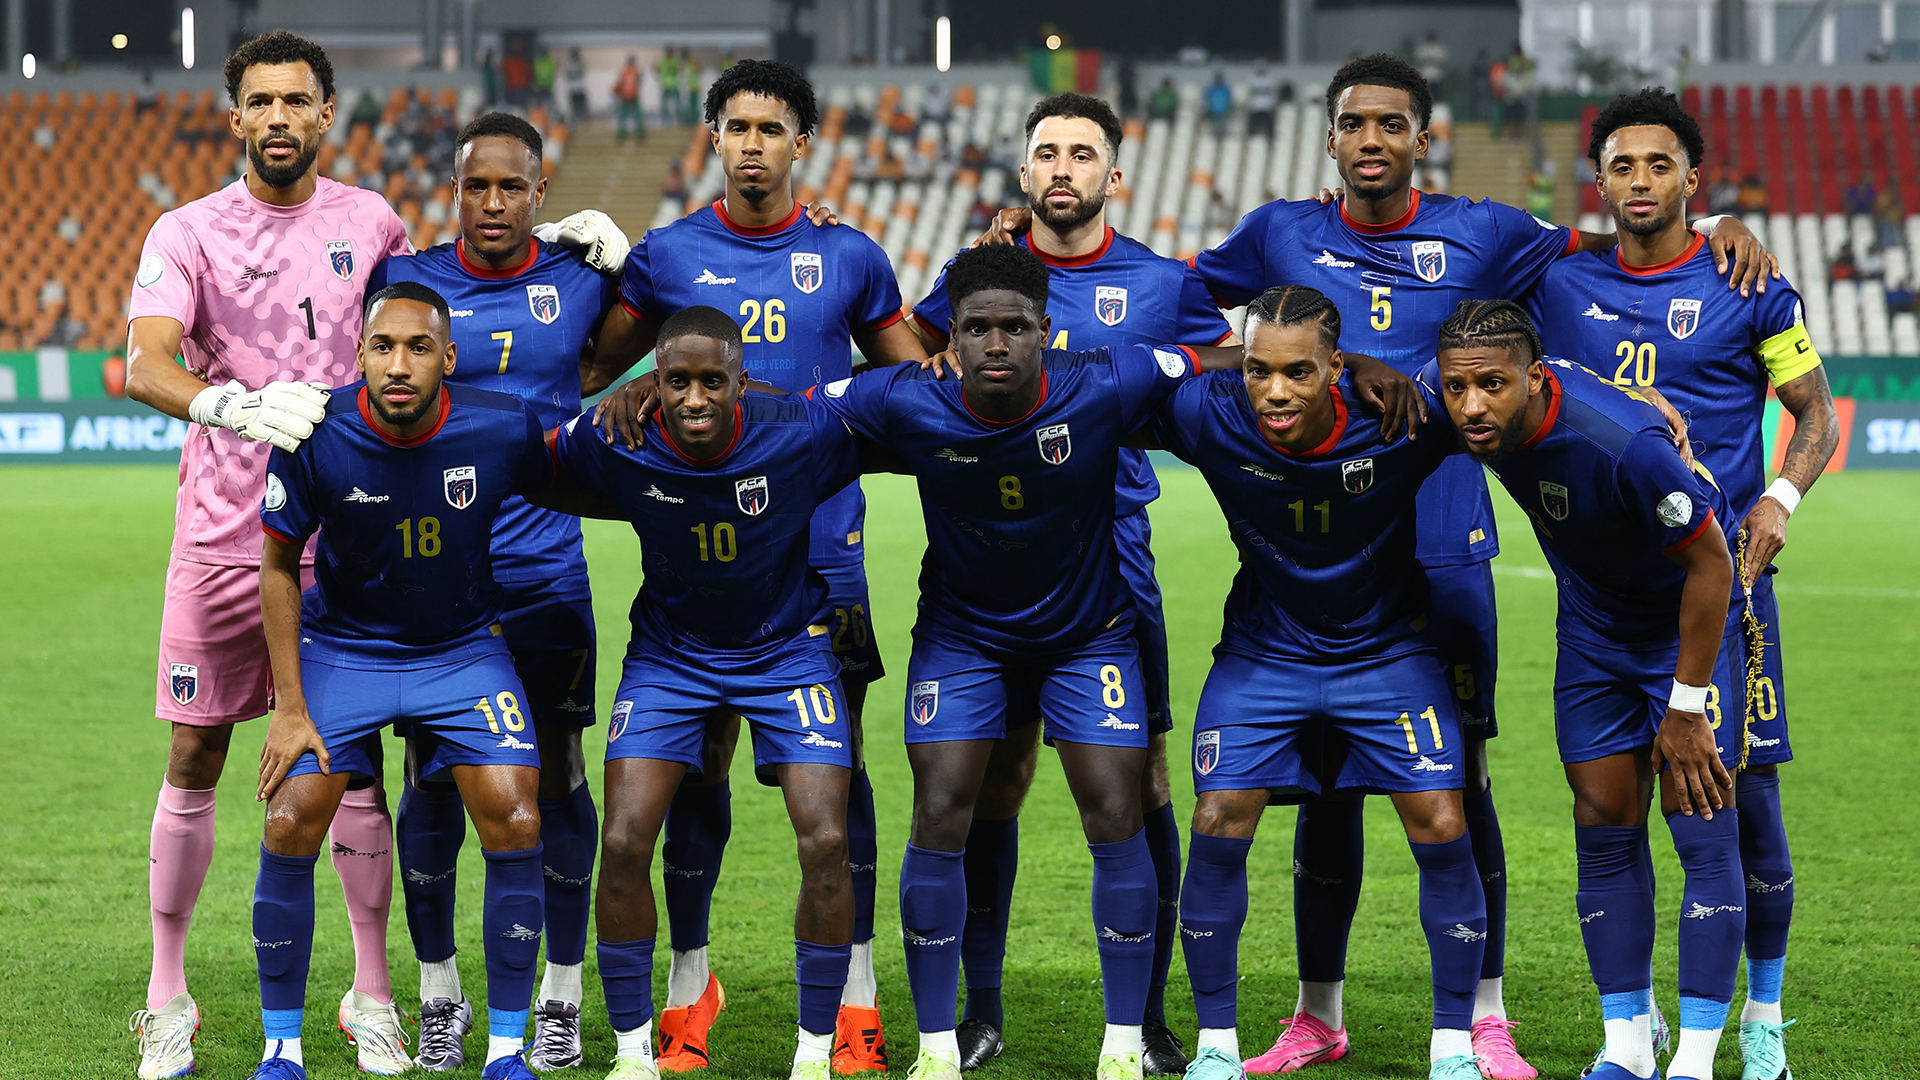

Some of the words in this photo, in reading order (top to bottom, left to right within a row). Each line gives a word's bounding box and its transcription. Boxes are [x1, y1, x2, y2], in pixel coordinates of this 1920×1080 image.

[327, 241, 349, 250] FCF
[1326, 258, 1355, 268] tempo
[250, 268, 278, 281] tempo
[708, 275, 737, 286] tempo
[1097, 288, 1124, 296] FCF
[1370, 287, 1392, 331] 5
[298, 297, 316, 340] 1
[739, 299, 786, 343] 26
[1593, 311, 1619, 322] tempo
[491, 331, 513, 374] 7
[769, 359, 796, 370] VERDE
[1614, 341, 1657, 387] 20
[69, 415, 188, 450] AFRICA
[1039, 426, 1066, 437] FCF
[949, 454, 978, 464] tempo
[1344, 460, 1373, 470] FCF
[446, 469, 473, 478] FCF
[1255, 470, 1284, 481] tempo
[738, 479, 763, 487] FCF
[1541, 484, 1566, 493] FCF
[999, 475, 1024, 510] 8
[359, 494, 389, 504] tempo
[656, 494, 684, 504] tempo
[1288, 500, 1330, 533] 11
[396, 517, 441, 558] 18
[691, 522, 737, 562] 10
[833, 604, 868, 651] 26
[172, 665, 196, 673] FCF
[569, 649, 588, 690] 7
[914, 683, 936, 691] FCF
[1100, 664, 1126, 709] 8
[1454, 664, 1475, 699] 5
[787, 683, 836, 728] 10
[474, 691, 526, 734] 18
[1112, 721, 1140, 731] tempo
[1395, 705, 1443, 754] 11
[1198, 733, 1216, 741] FCF
[512, 742, 535, 750] tempo
[816, 738, 843, 749] tempo
[1752, 738, 1780, 748] tempo
[1426, 762, 1453, 772] tempo
[344, 849, 388, 859] tempo
[420, 867, 455, 885] tempo
[557, 873, 590, 886] tempo
[1756, 876, 1793, 894] tempo
[1700, 904, 1742, 919] tempo
[912, 934, 955, 946] tempo
[1110, 931, 1151, 944] tempo
[254, 939, 292, 949] empo
